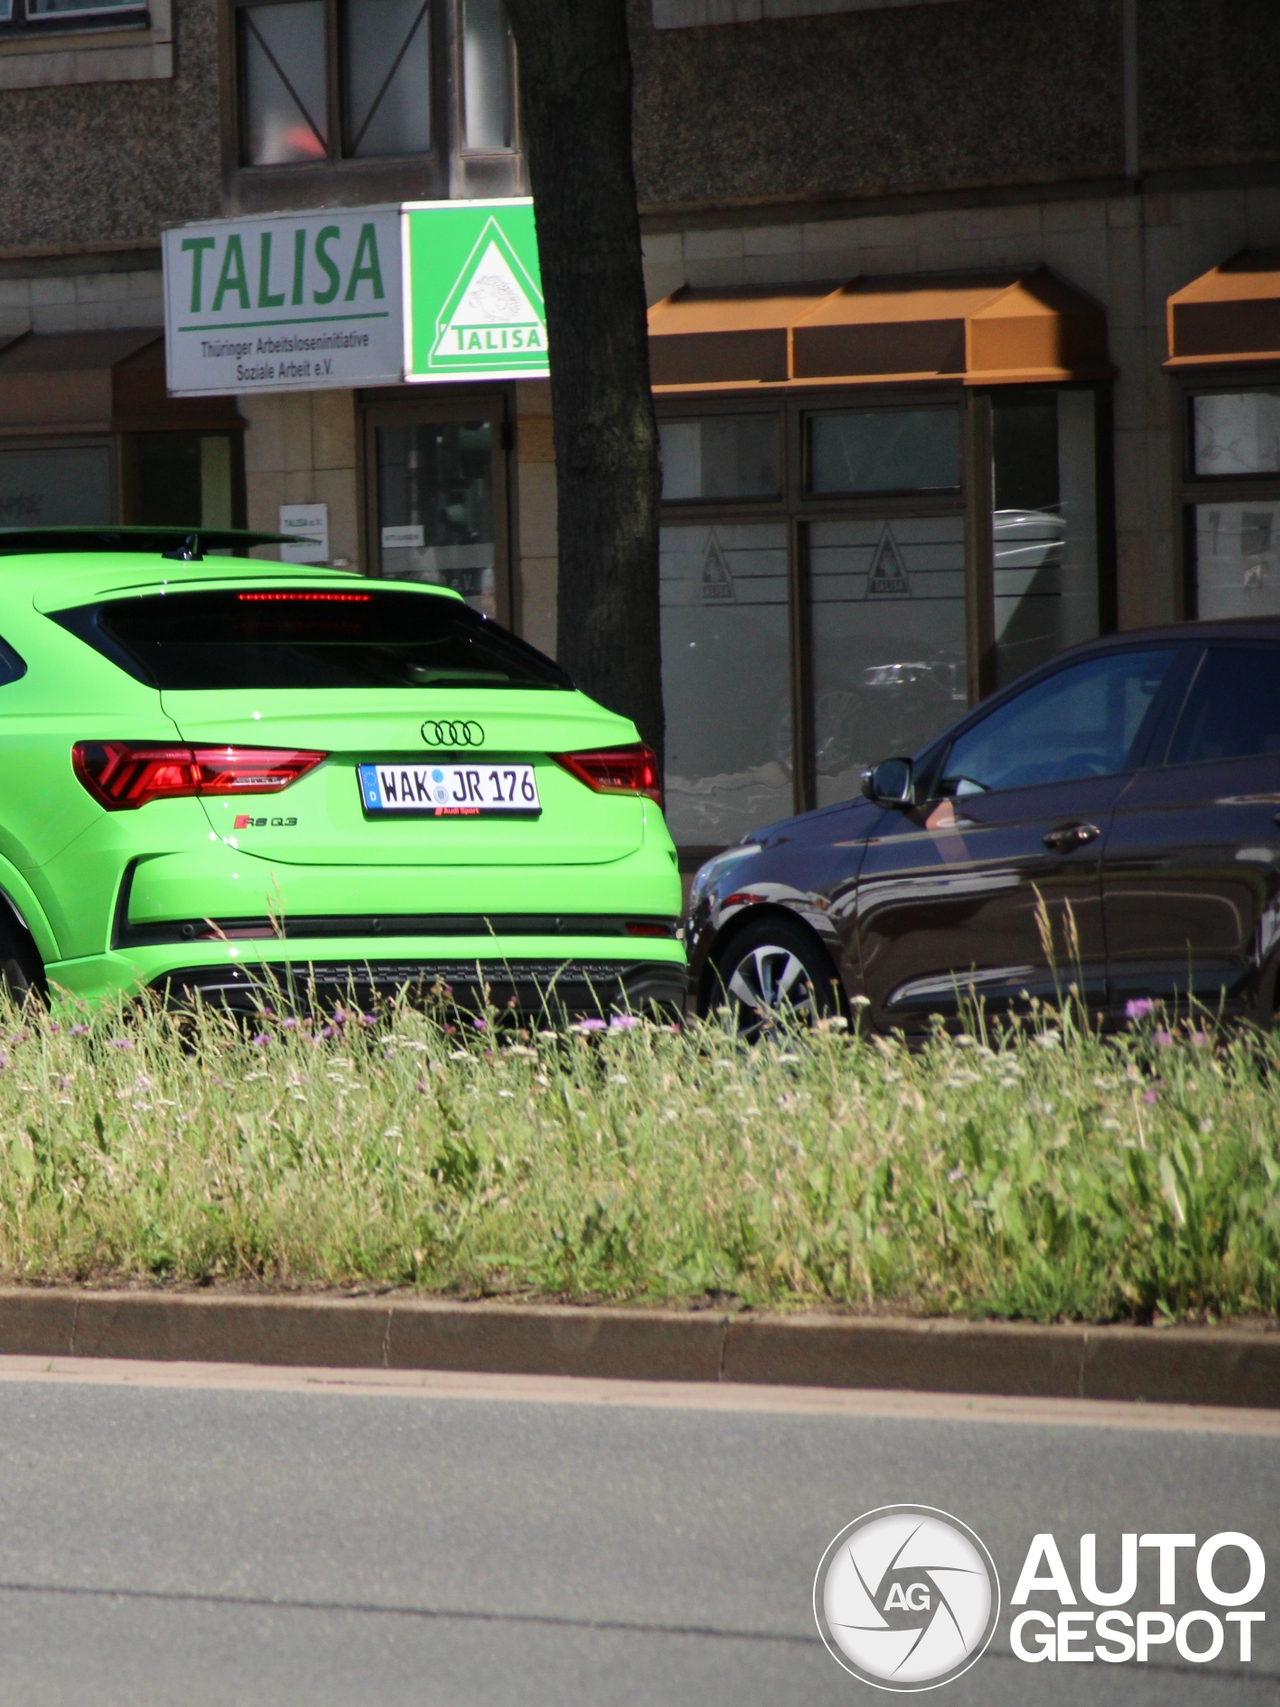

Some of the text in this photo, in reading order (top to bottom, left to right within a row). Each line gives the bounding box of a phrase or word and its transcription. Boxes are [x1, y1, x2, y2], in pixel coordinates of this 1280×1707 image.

[180, 222, 385, 313] TALISA
[200, 330, 369, 360] Thüringer Arbeitsloseninitiative
[450, 321, 542, 351] TALISA
[236, 357, 334, 382] Soziale Arbeit e.V.
[370, 791, 377, 801] D
[380, 770, 535, 803] WAK JR 176
[270, 817, 298, 827] Q3
